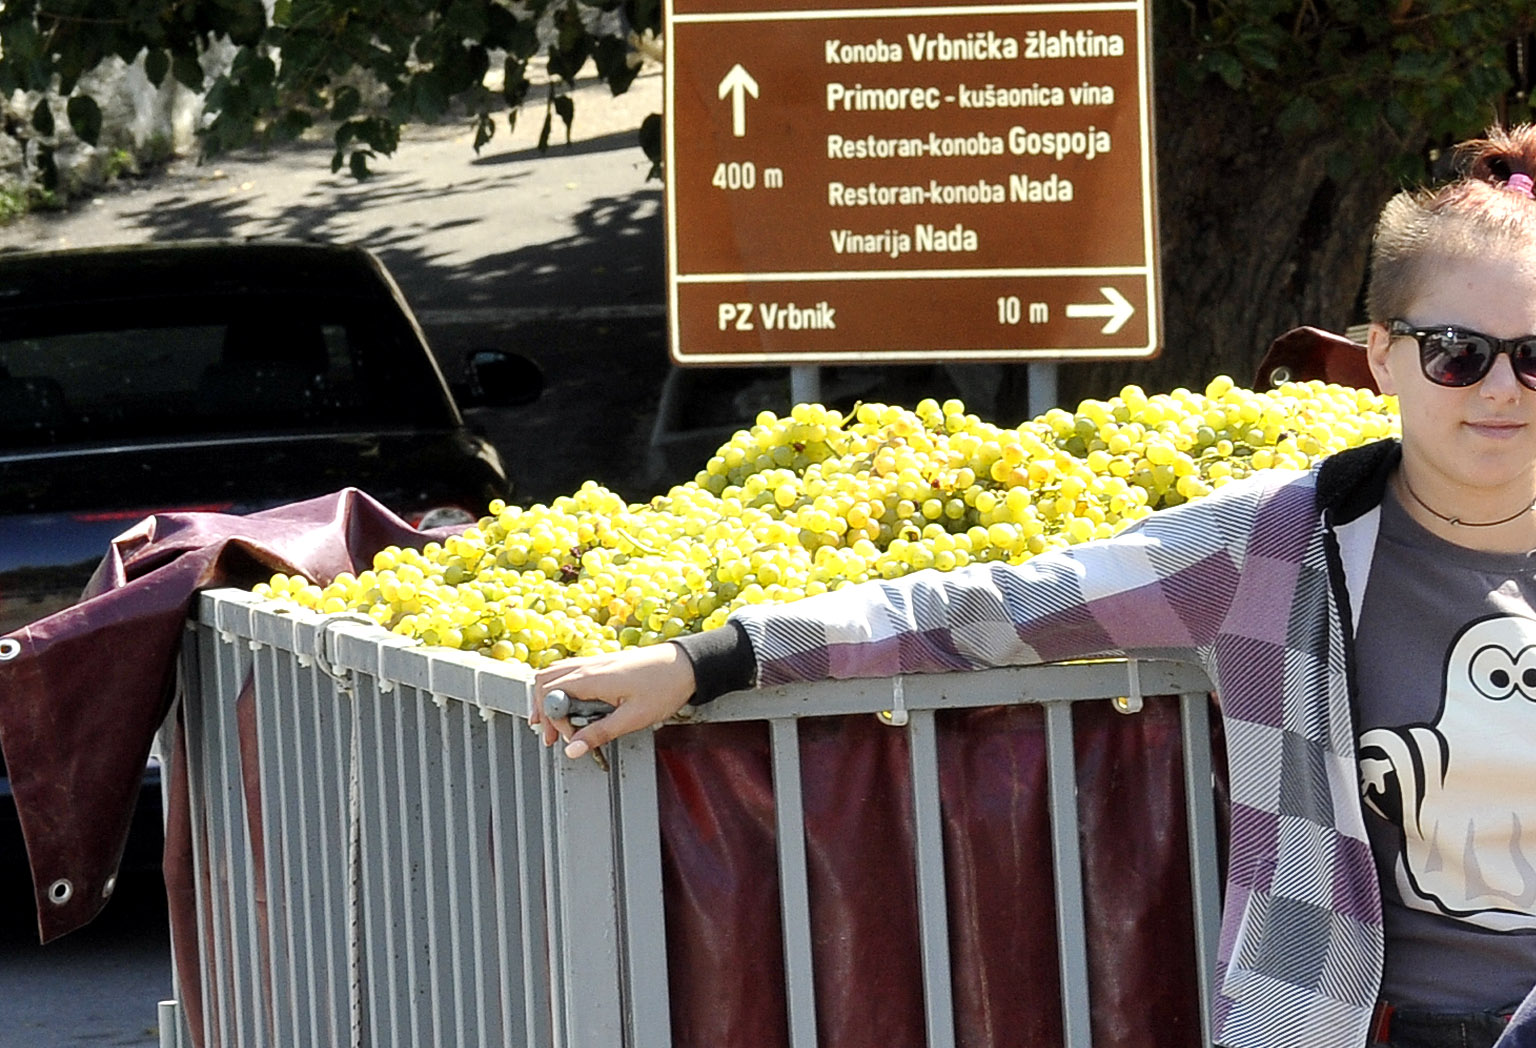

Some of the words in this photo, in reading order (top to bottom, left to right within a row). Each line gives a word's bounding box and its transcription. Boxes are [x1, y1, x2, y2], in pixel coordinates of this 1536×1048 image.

[825, 38, 903, 64] Konoba
[907, 30, 1019, 62] Vrbnička
[1024, 29, 1125, 59] žlahtina
[826, 82, 940, 111] Primorec
[958, 82, 1065, 108] kušaonica
[1068, 81, 1114, 106] vina
[827, 131, 1004, 159] Restoran-konoba
[1008, 125, 1111, 161] Gospoja
[712, 161, 756, 190] 400
[763, 167, 783, 189] m
[828, 179, 1006, 207] Restoran-konoba
[1009, 173, 1073, 203] Nada
[830, 229, 911, 259] Vinarija
[915, 223, 978, 252] Nada
[718, 303, 754, 331] PZ
[759, 301, 836, 330] Vrbnik
[997, 296, 1021, 325] 10
[1029, 302, 1049, 324] m
